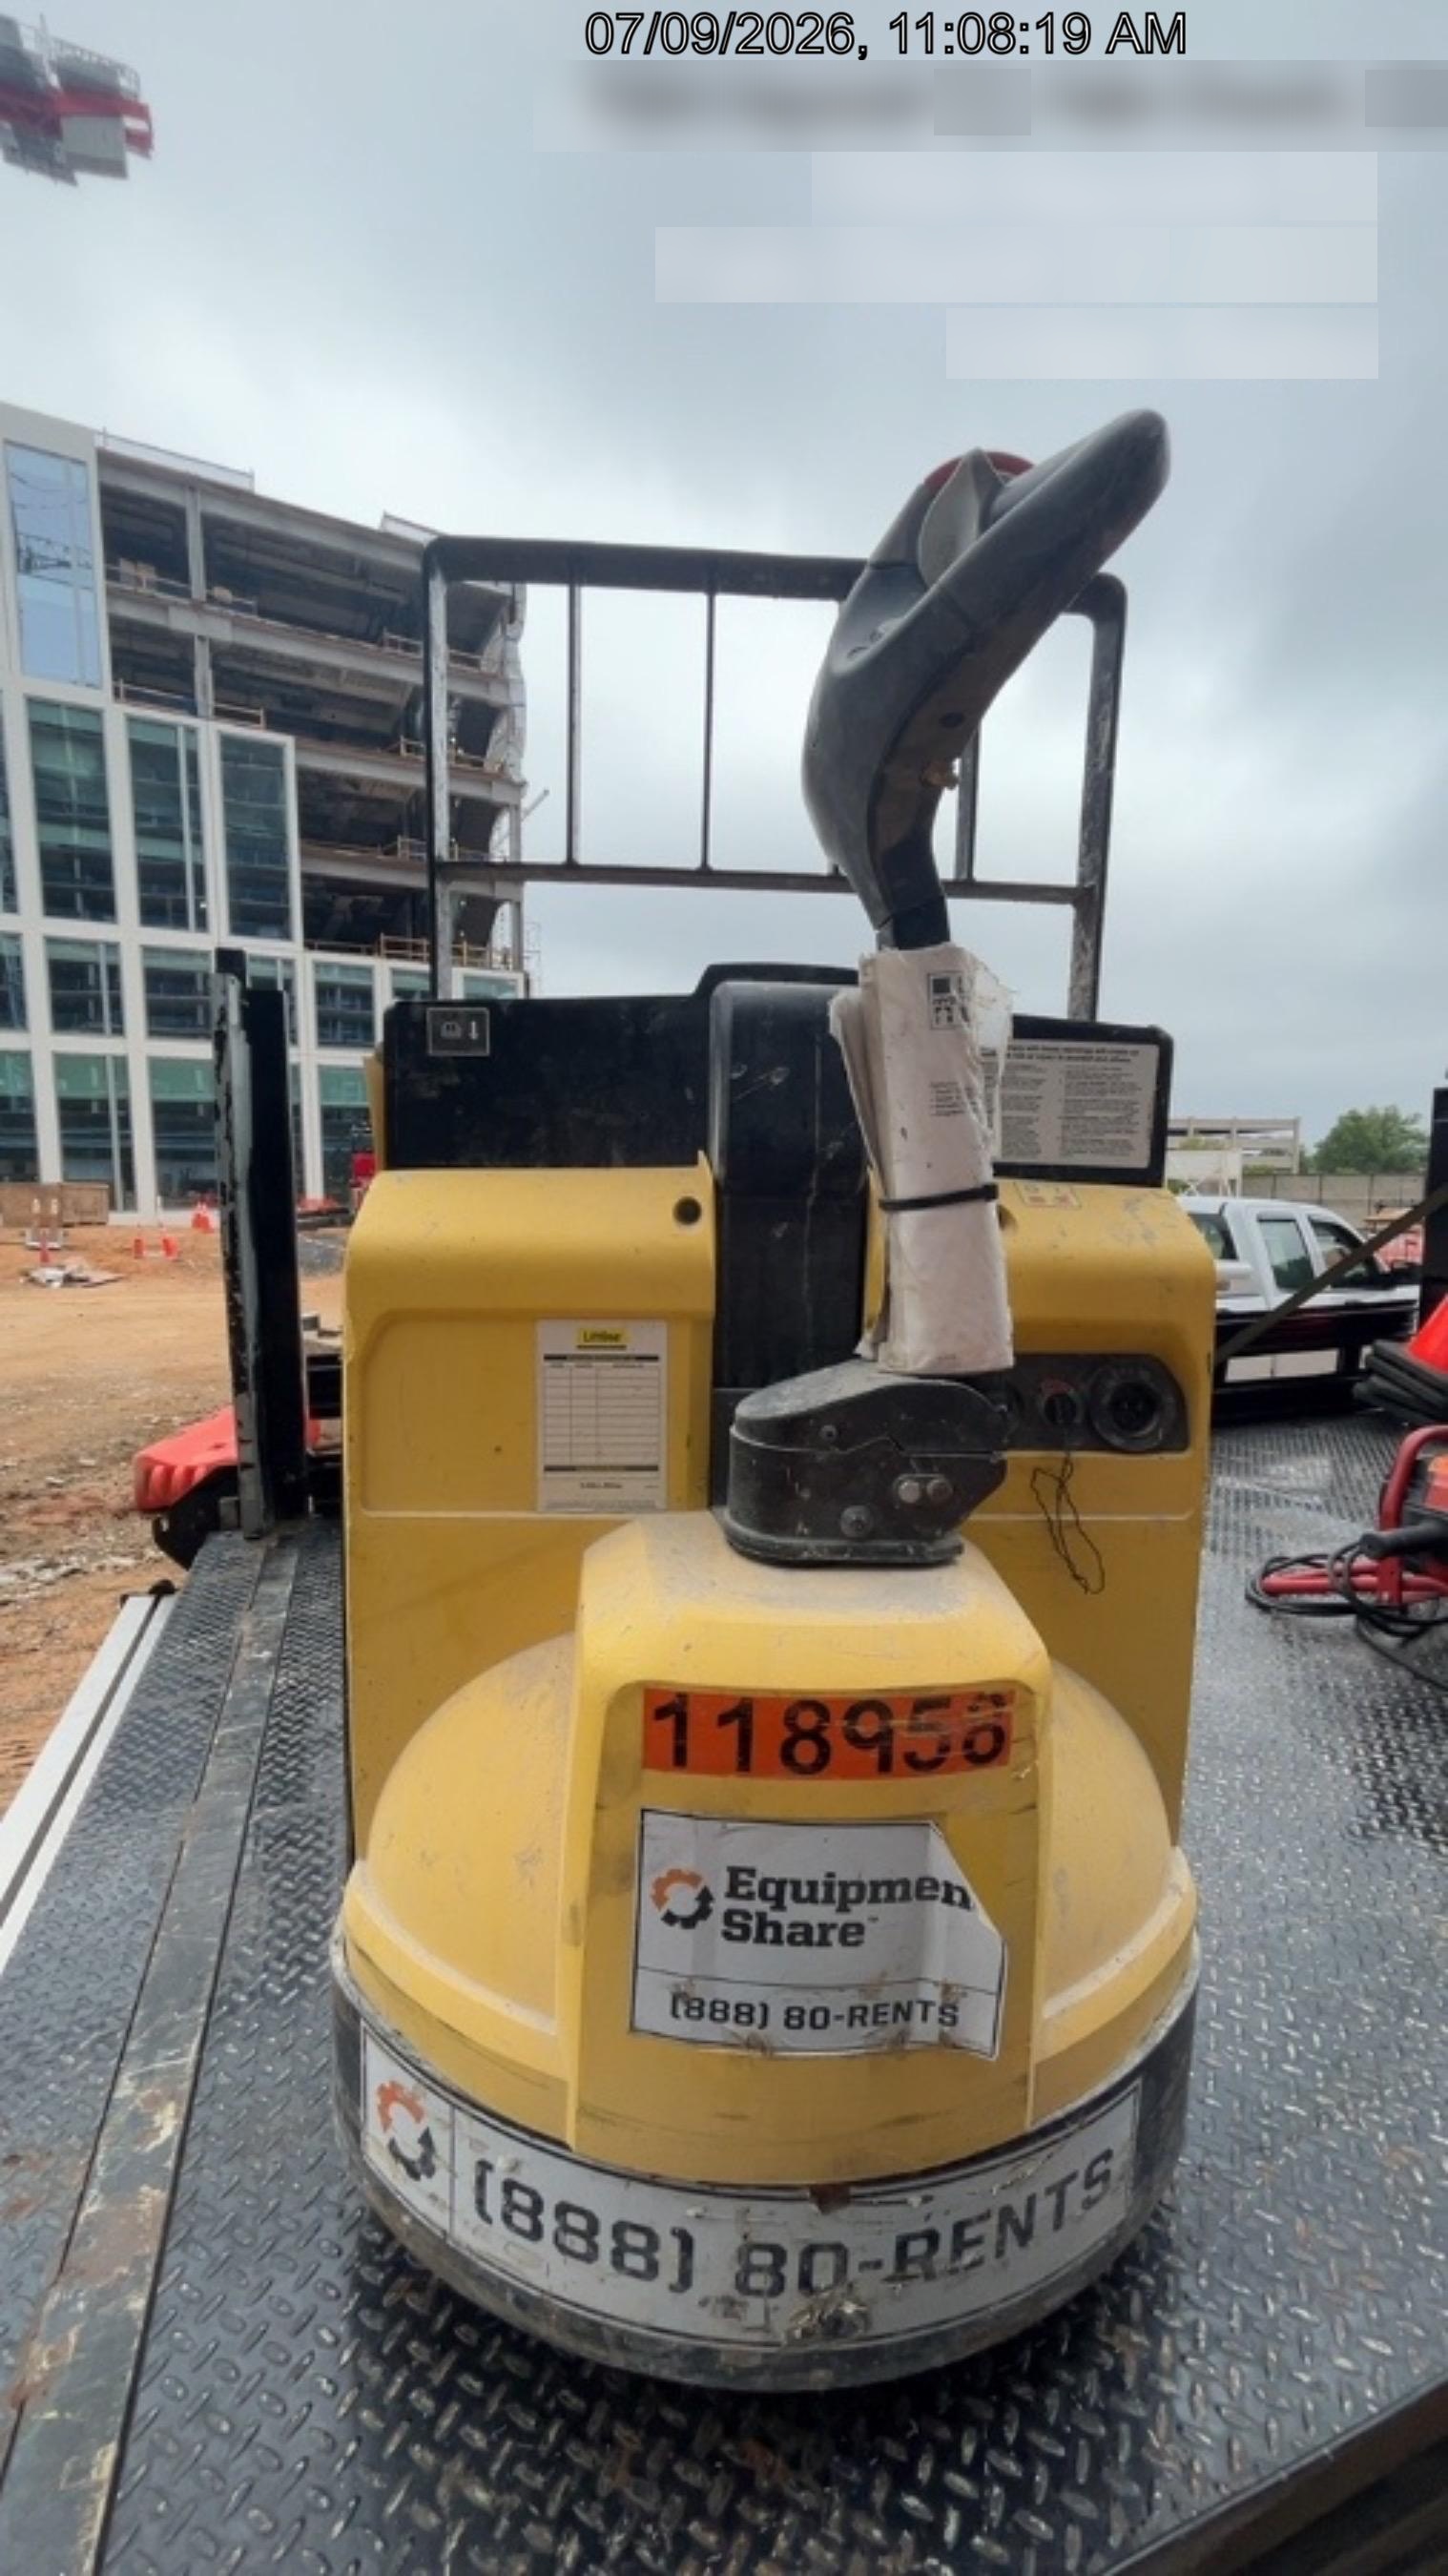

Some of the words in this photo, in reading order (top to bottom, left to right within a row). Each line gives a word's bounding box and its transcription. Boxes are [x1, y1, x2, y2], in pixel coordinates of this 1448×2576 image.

[724, 1865, 975, 1913] Equipmen
[721, 1908, 865, 1947] Share
[671, 1991, 769, 2030] (888)
[783, 2000, 960, 2031] 80-RENTS
[474, 2158, 694, 2294] (888)
[734, 2148, 1114, 2299] 80-RENTS
